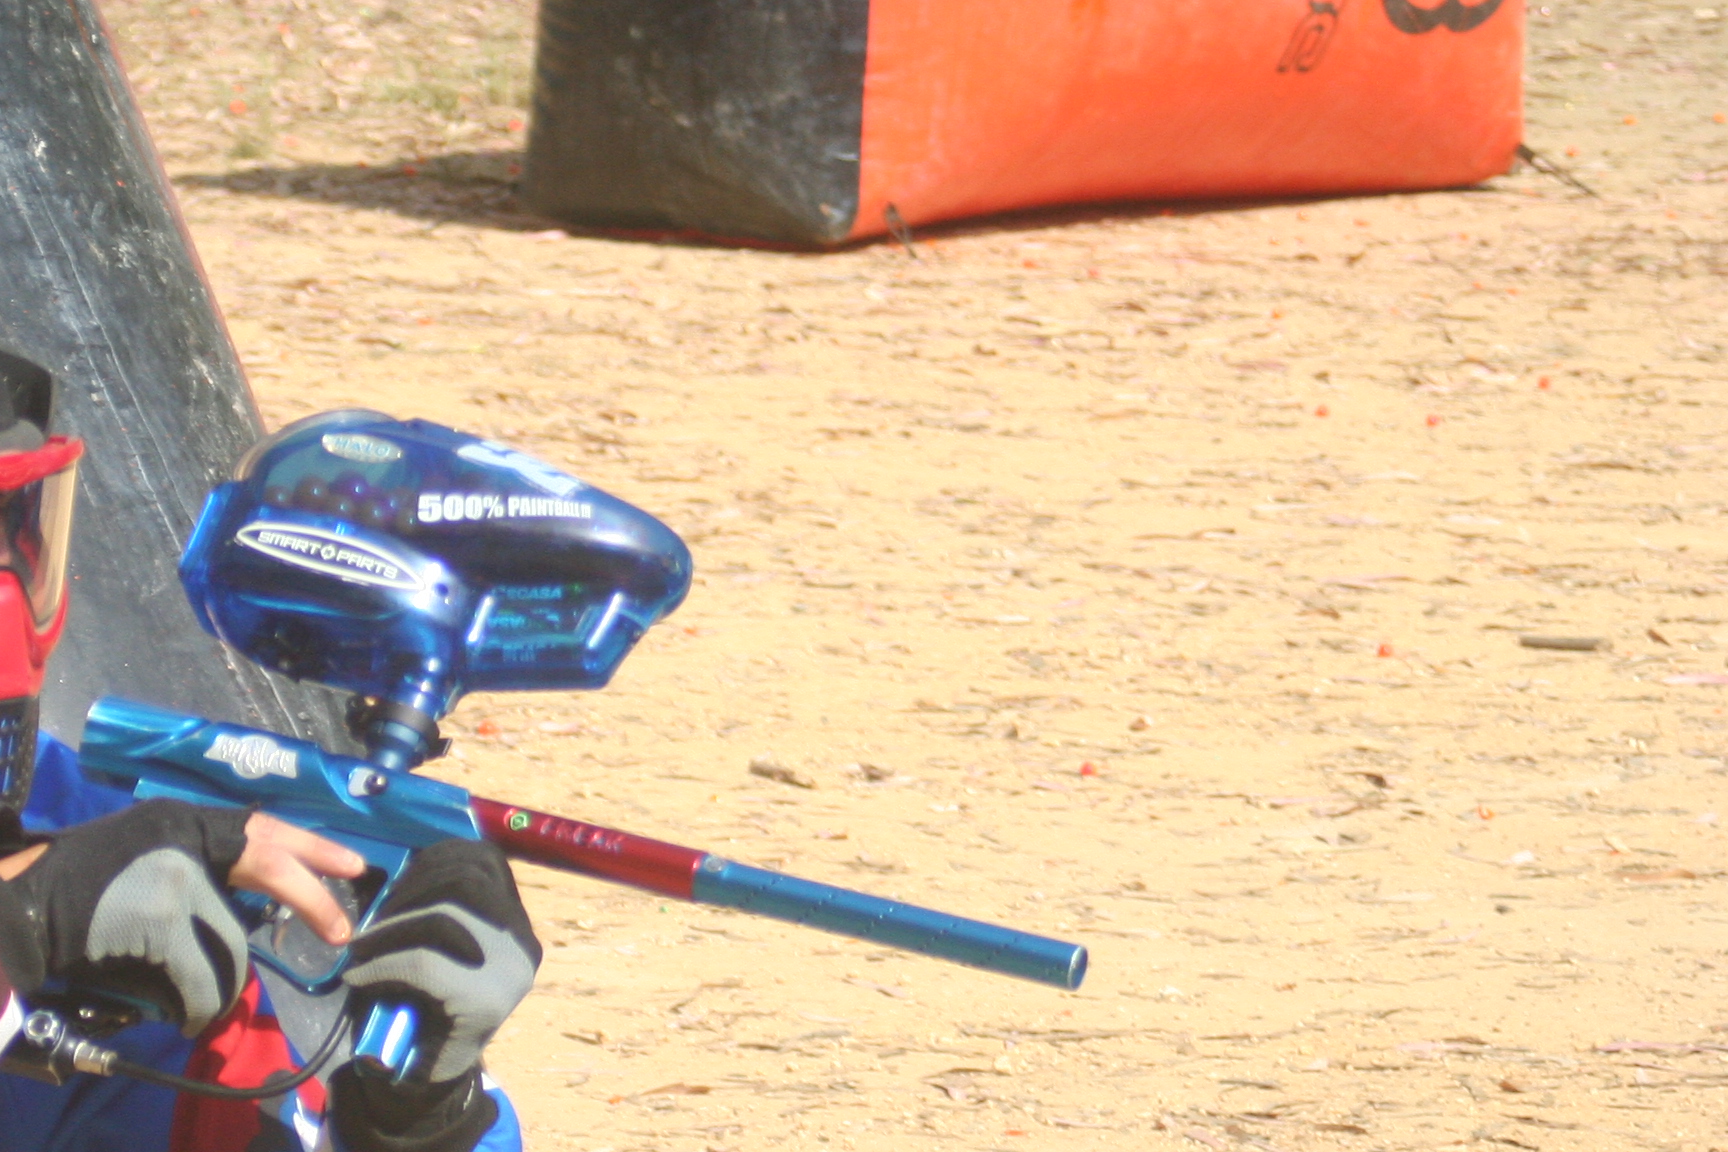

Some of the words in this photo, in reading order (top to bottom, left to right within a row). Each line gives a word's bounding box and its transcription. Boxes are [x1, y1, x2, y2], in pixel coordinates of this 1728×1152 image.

[332, 434, 392, 459] HALO
[417, 493, 504, 523] 500%
[507, 495, 580, 518] PAINTBALL
[257, 531, 322, 556] SMART
[335, 549, 398, 580] PARTS
